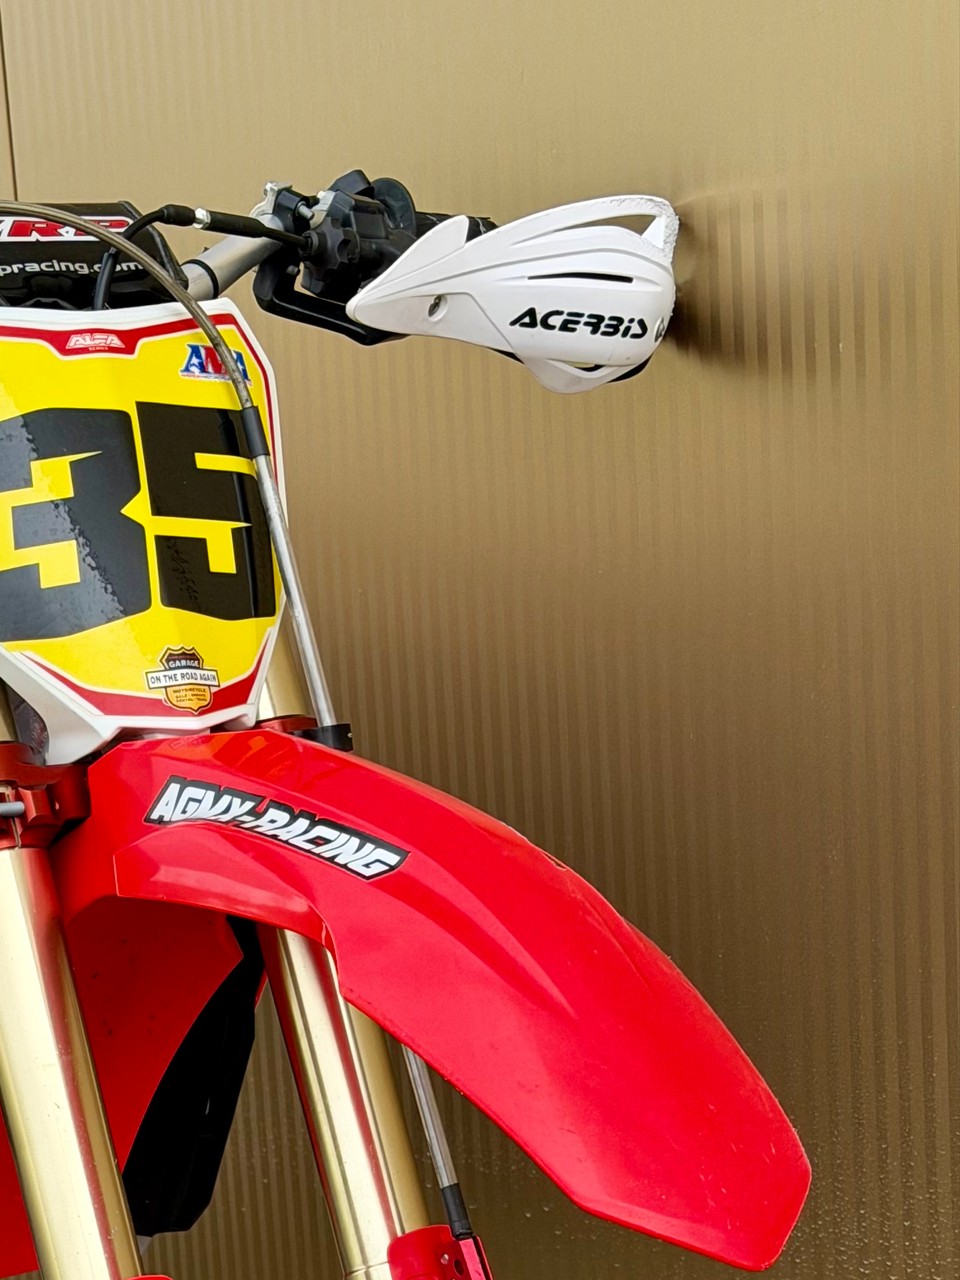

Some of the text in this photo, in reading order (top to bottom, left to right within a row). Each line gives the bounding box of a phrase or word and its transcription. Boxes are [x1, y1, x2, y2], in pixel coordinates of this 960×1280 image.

[509, 307, 648, 339] ACERBIS
[168, 659, 200, 668] GARAGE
[150, 671, 217, 685] ON THE ROAD AGAIN
